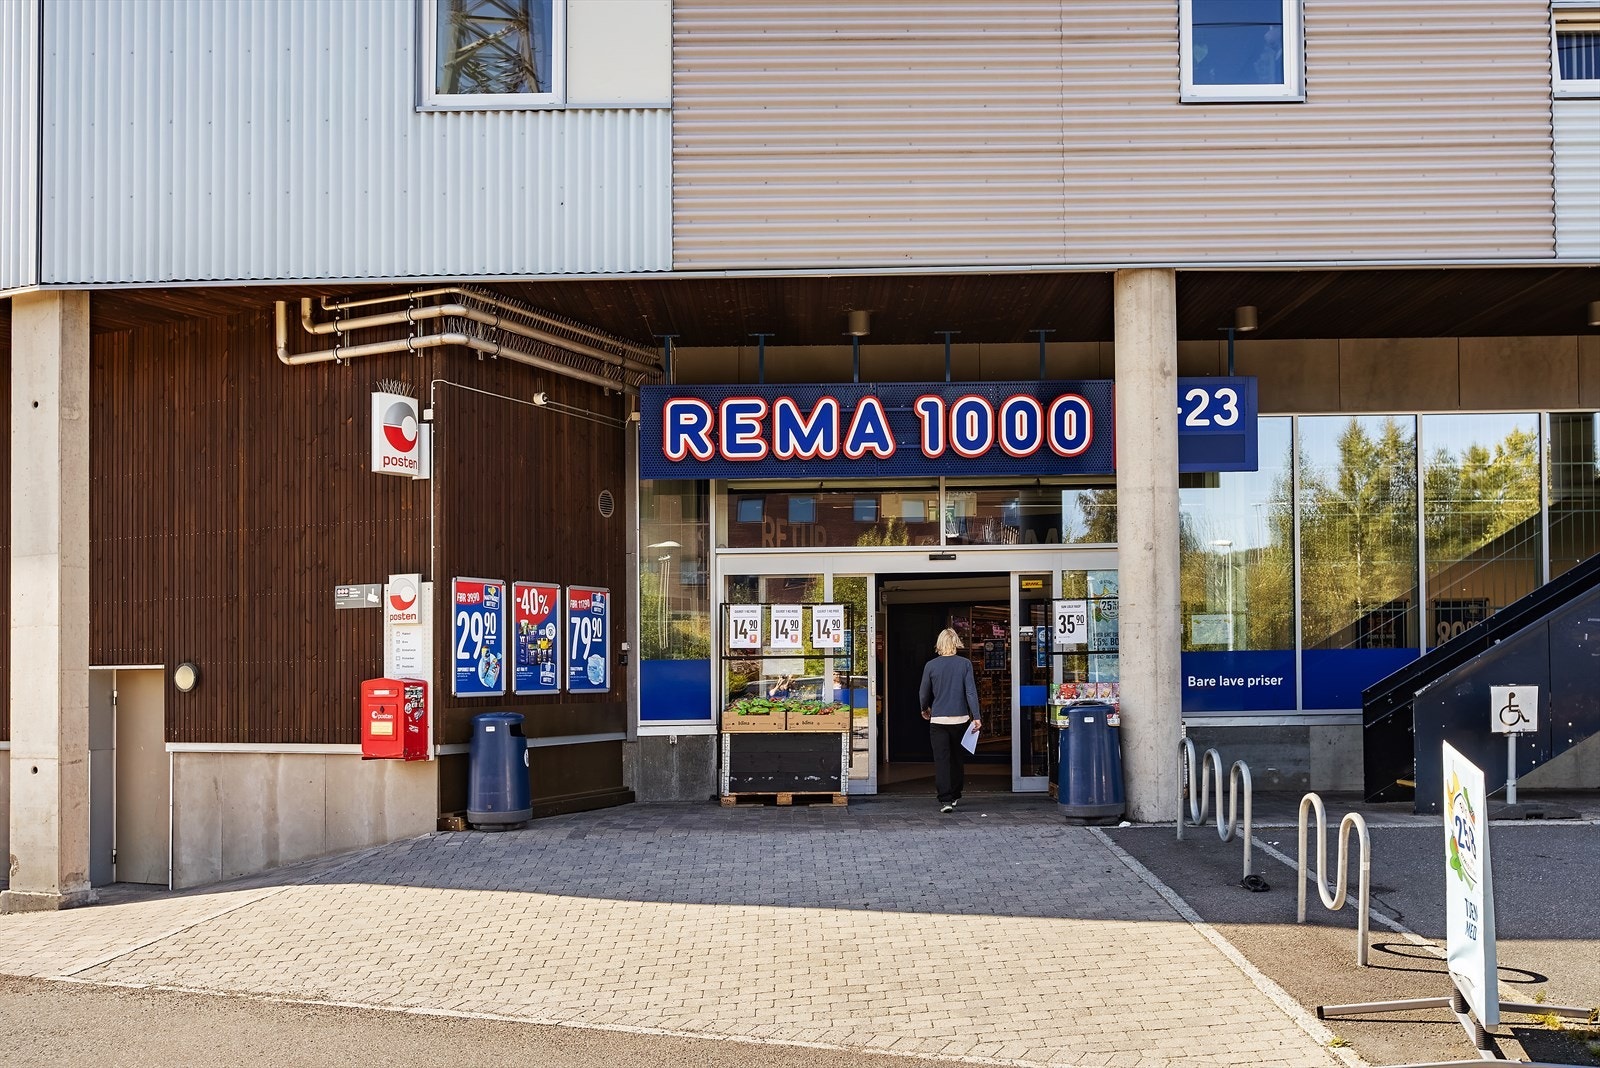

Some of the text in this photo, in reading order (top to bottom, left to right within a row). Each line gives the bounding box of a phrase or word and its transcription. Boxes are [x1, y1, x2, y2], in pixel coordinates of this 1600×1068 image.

[663, 394, 1093, 462] REMA 1000
[383, 456, 418, 470] posten
[516, 588, 549, 615] -40%
[389, 612, 417, 622] posten
[1058, 614, 1085, 634] 35 90
[457, 610, 497, 660] 29 90
[571, 616, 602, 660] 79 90
[733, 619, 758, 639] 14 90
[775, 619, 799, 639] 14 90
[816, 619, 841, 639] 14 90
[1187, 674, 1284, 688] Bare lave priser
